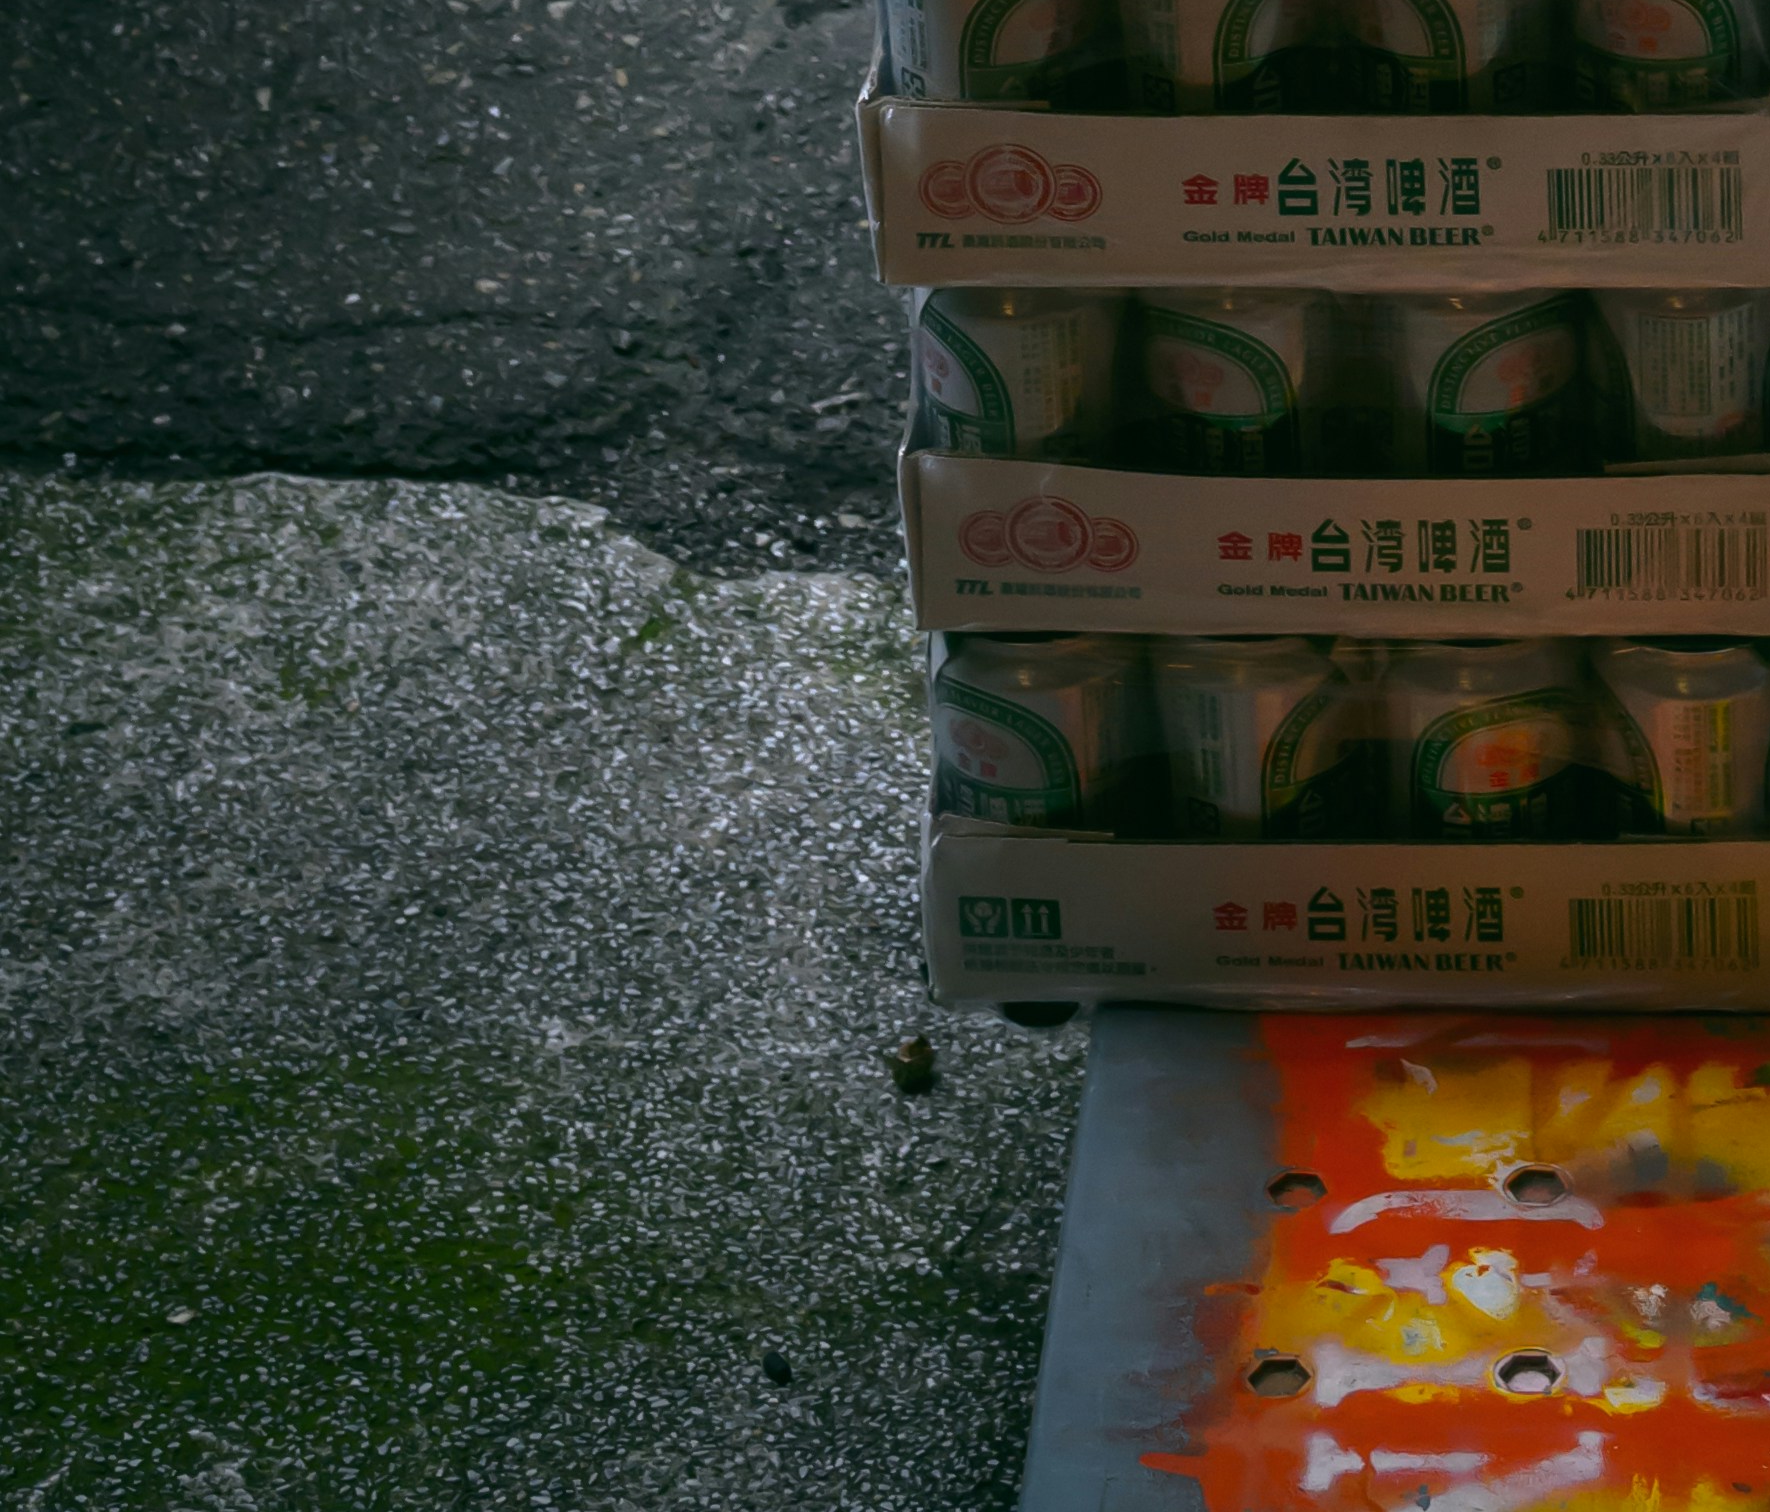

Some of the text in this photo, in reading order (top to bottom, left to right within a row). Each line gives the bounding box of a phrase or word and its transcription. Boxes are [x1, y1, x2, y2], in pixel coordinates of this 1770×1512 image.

[1181, 172, 1270, 206] 金牌
[1182, 227, 1482, 247] Gold Medal TAIWAN BEER
[1217, 530, 1303, 562] 金牌
[1217, 582, 1511, 603] Gold Medal TAIWAN BEER
[1213, 901, 1297, 932] 金牌
[1215, 952, 1504, 972] Gold Medal TAIWAN BEER
